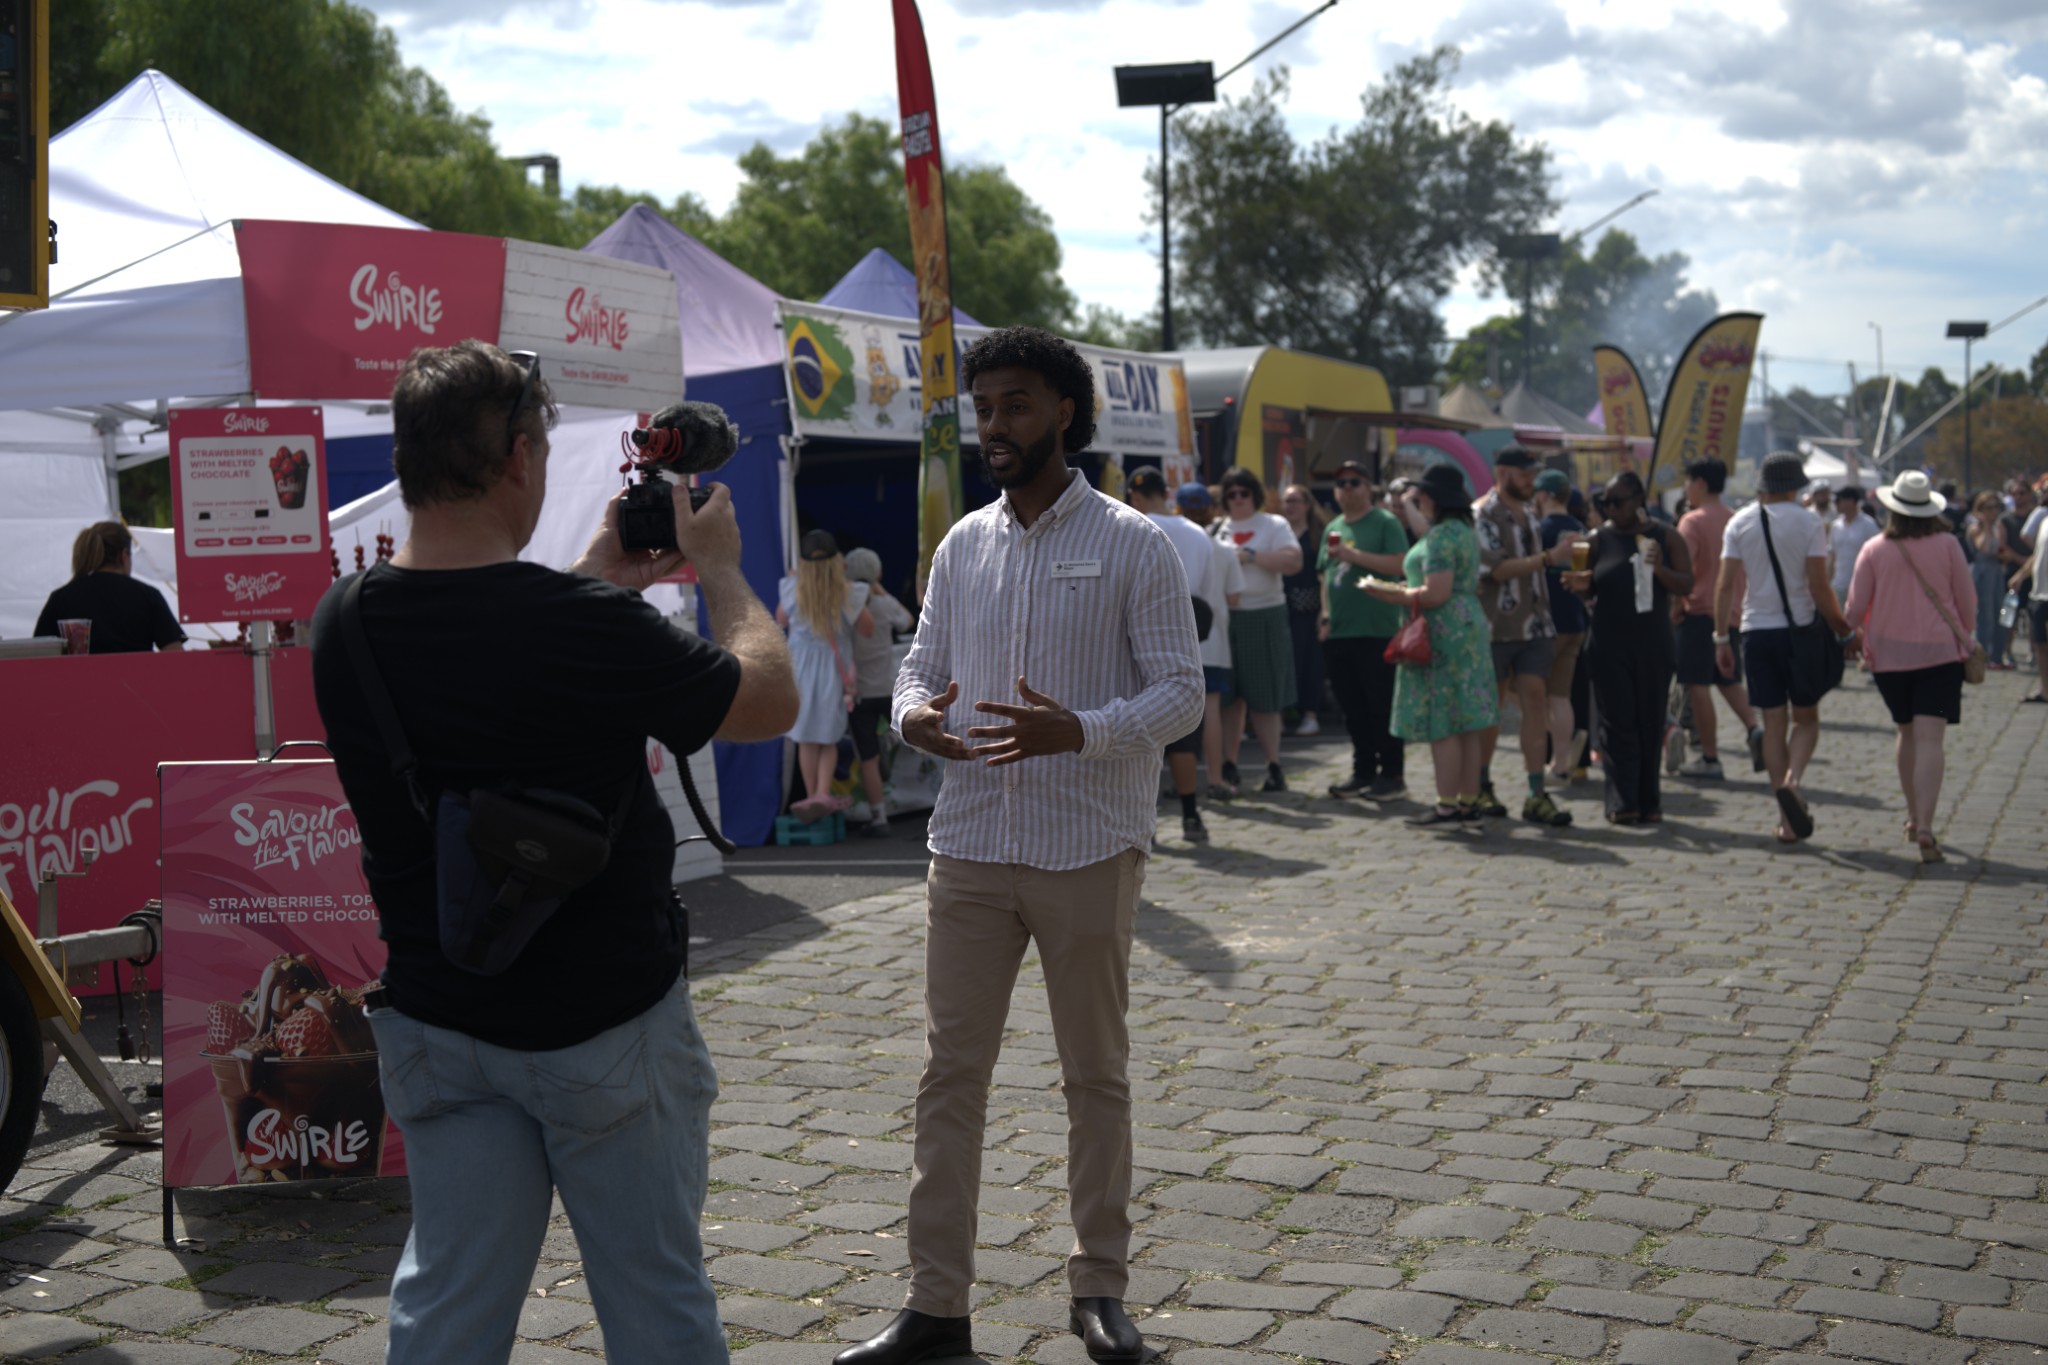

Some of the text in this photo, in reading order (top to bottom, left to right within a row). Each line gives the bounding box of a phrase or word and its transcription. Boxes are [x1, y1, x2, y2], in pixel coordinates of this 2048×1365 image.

[1703, 384, 1730, 458] ONUTS
[189, 448, 264, 458] STRAWBERRIES
[190, 458, 256, 469] WITH MELTED
[190, 469, 251, 480] CHOCOLATE
[253, 823, 363, 871] the Flavou
[208, 895, 338, 910] STRAWBERRIES,
[198, 909, 380, 925] WITH MELTED CHOCOL
